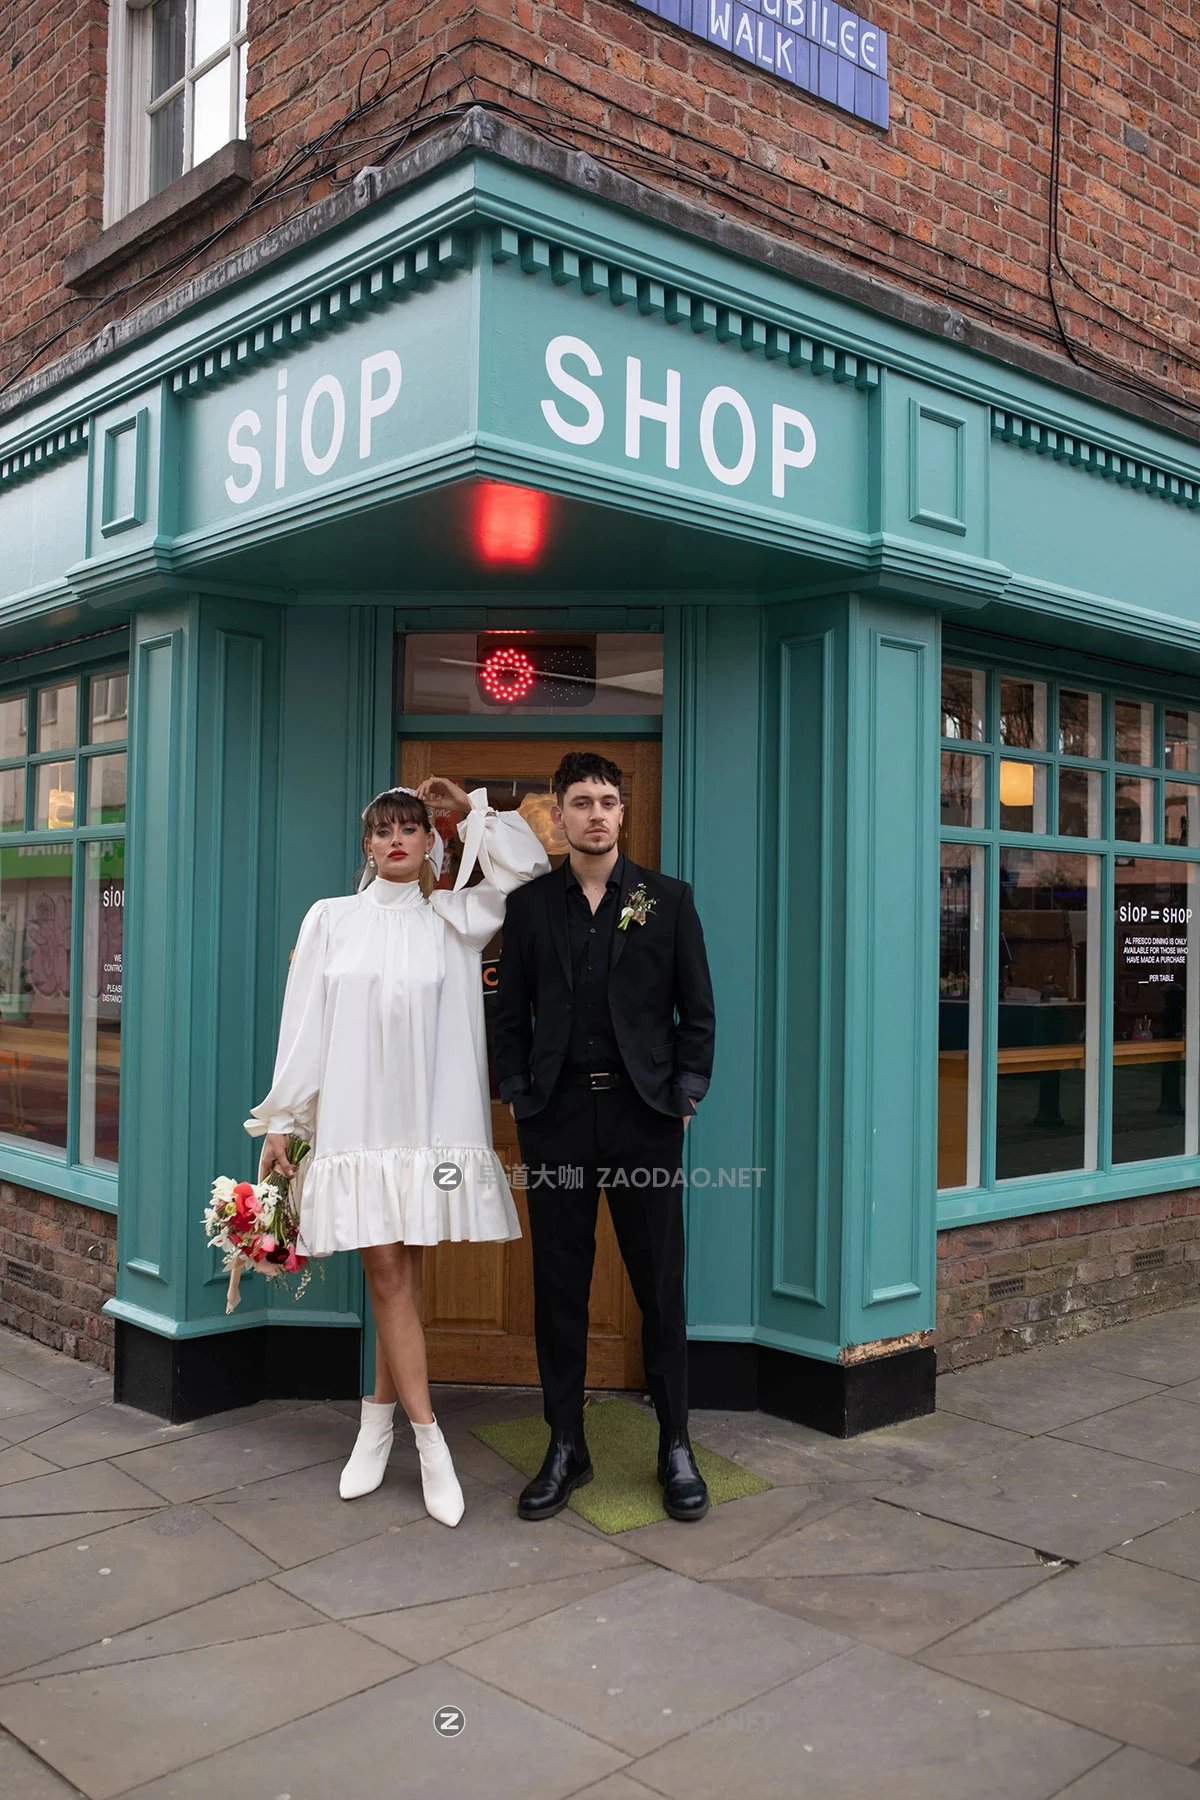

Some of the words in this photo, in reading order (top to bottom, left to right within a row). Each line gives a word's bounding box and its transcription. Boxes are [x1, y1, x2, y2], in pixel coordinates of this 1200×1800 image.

[710, 0, 794, 74] WALK
[744, 0, 877, 69] BILEE
[540, 334, 817, 499] SHOP
[1162, 907, 1193, 924] SHOP
[1132, 937, 1152, 945] FRESCO
[1152, 937, 1169, 945] DINING
[1169, 937, 1175, 945] IS
[1174, 937, 1188, 945] ONLY
[1123, 946, 1149, 954] AVAILABLE
[1149, 946, 1160, 954] FOR
[1160, 946, 1176, 954] THOSE
[1176, 946, 1189, 954] WHO
[113, 953, 122, 962] WE
[1126, 956, 1140, 964] HAVE
[1140, 956, 1155, 964] MADE
[1155, 956, 1160, 964] A
[1160, 956, 1186, 964] PURCHASE
[1149, 974, 1160, 982] PER
[1160, 974, 1175, 982] TABLE
